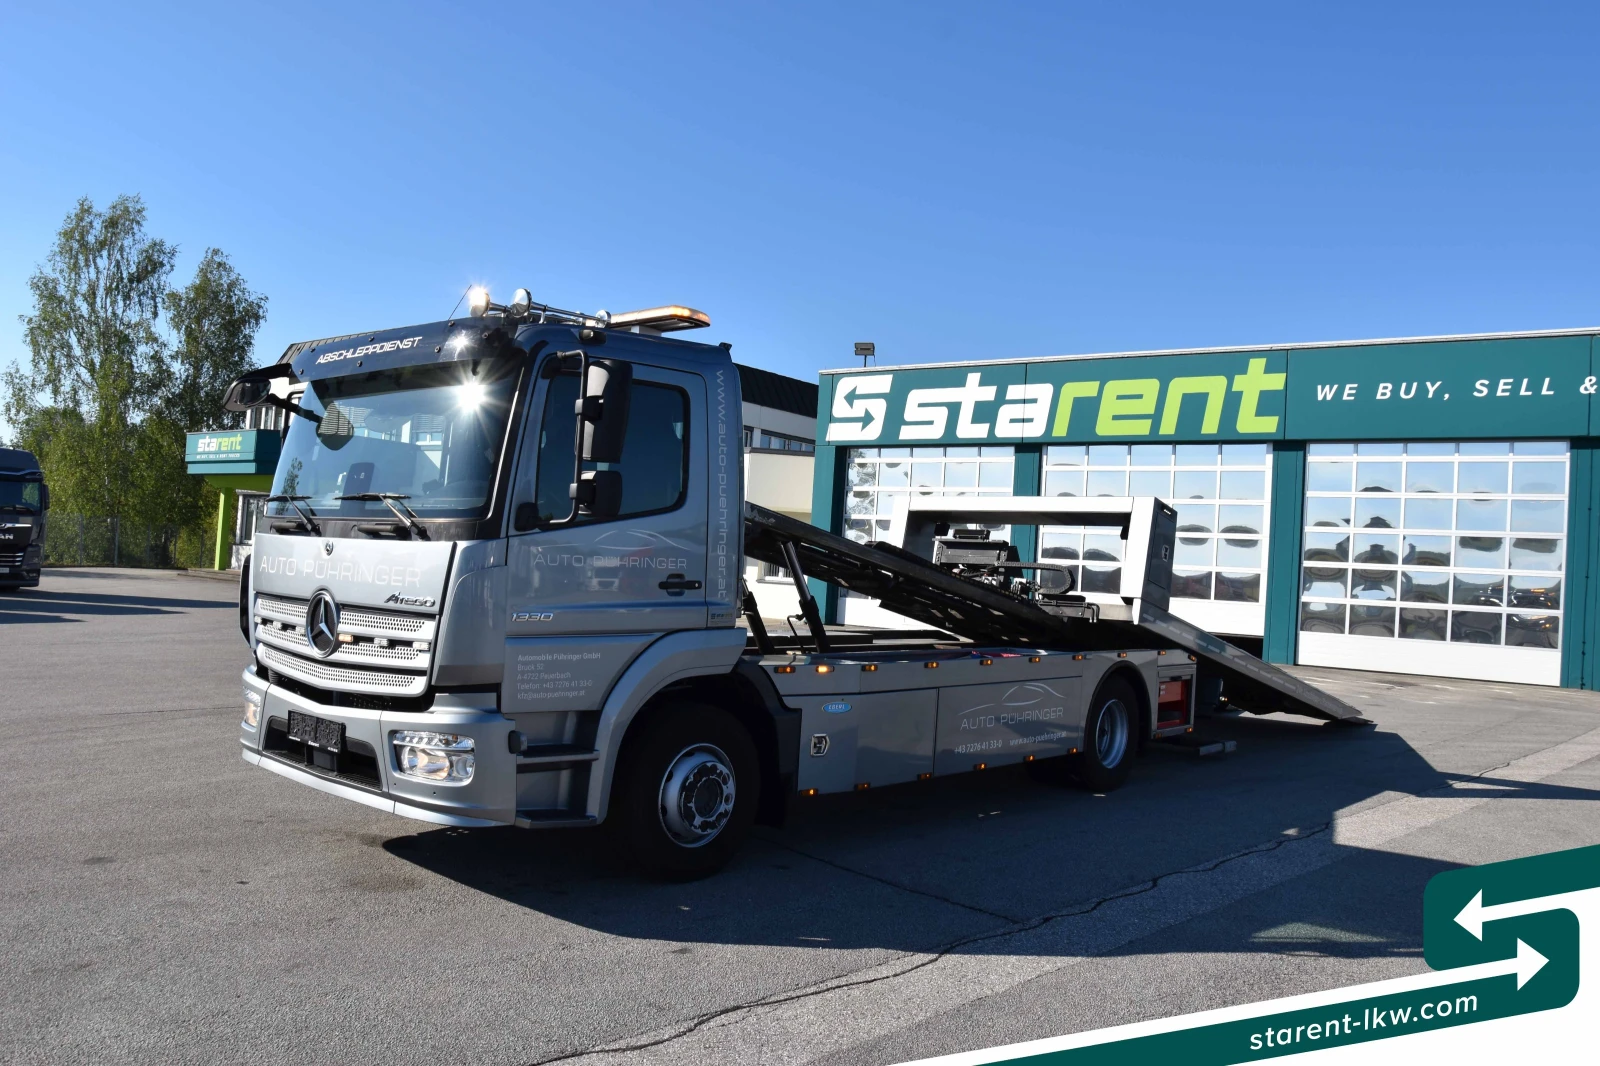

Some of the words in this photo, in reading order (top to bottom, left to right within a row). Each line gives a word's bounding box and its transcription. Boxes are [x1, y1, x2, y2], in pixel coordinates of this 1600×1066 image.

[315, 336, 423, 365] ABSCHLEPPDIENST
[898, 357, 1288, 440] starent
[1316, 384, 1359, 401] WE
[1375, 381, 1451, 401] BUY,
[1472, 377, 1556, 397] SELL
[1579, 375, 1598, 395] &
[197, 434, 242, 452] starent
[715, 369, 728, 599] www.auto-puehringer.at
[260, 556, 297, 576] AUTO
[303, 558, 421, 588] PÜHRINGER
[533, 554, 585, 567] AUTO
[593, 555, 688, 570] PÜHRINGER
[511, 612, 554, 622] 1330
[960, 716, 995, 731] AUTO
[1000, 707, 1065, 725] PÜHRINGER
[954, 744, 966, 754] +43
[966, 742, 980, 752] 7276
[990, 740, 1002, 749] 33-0
